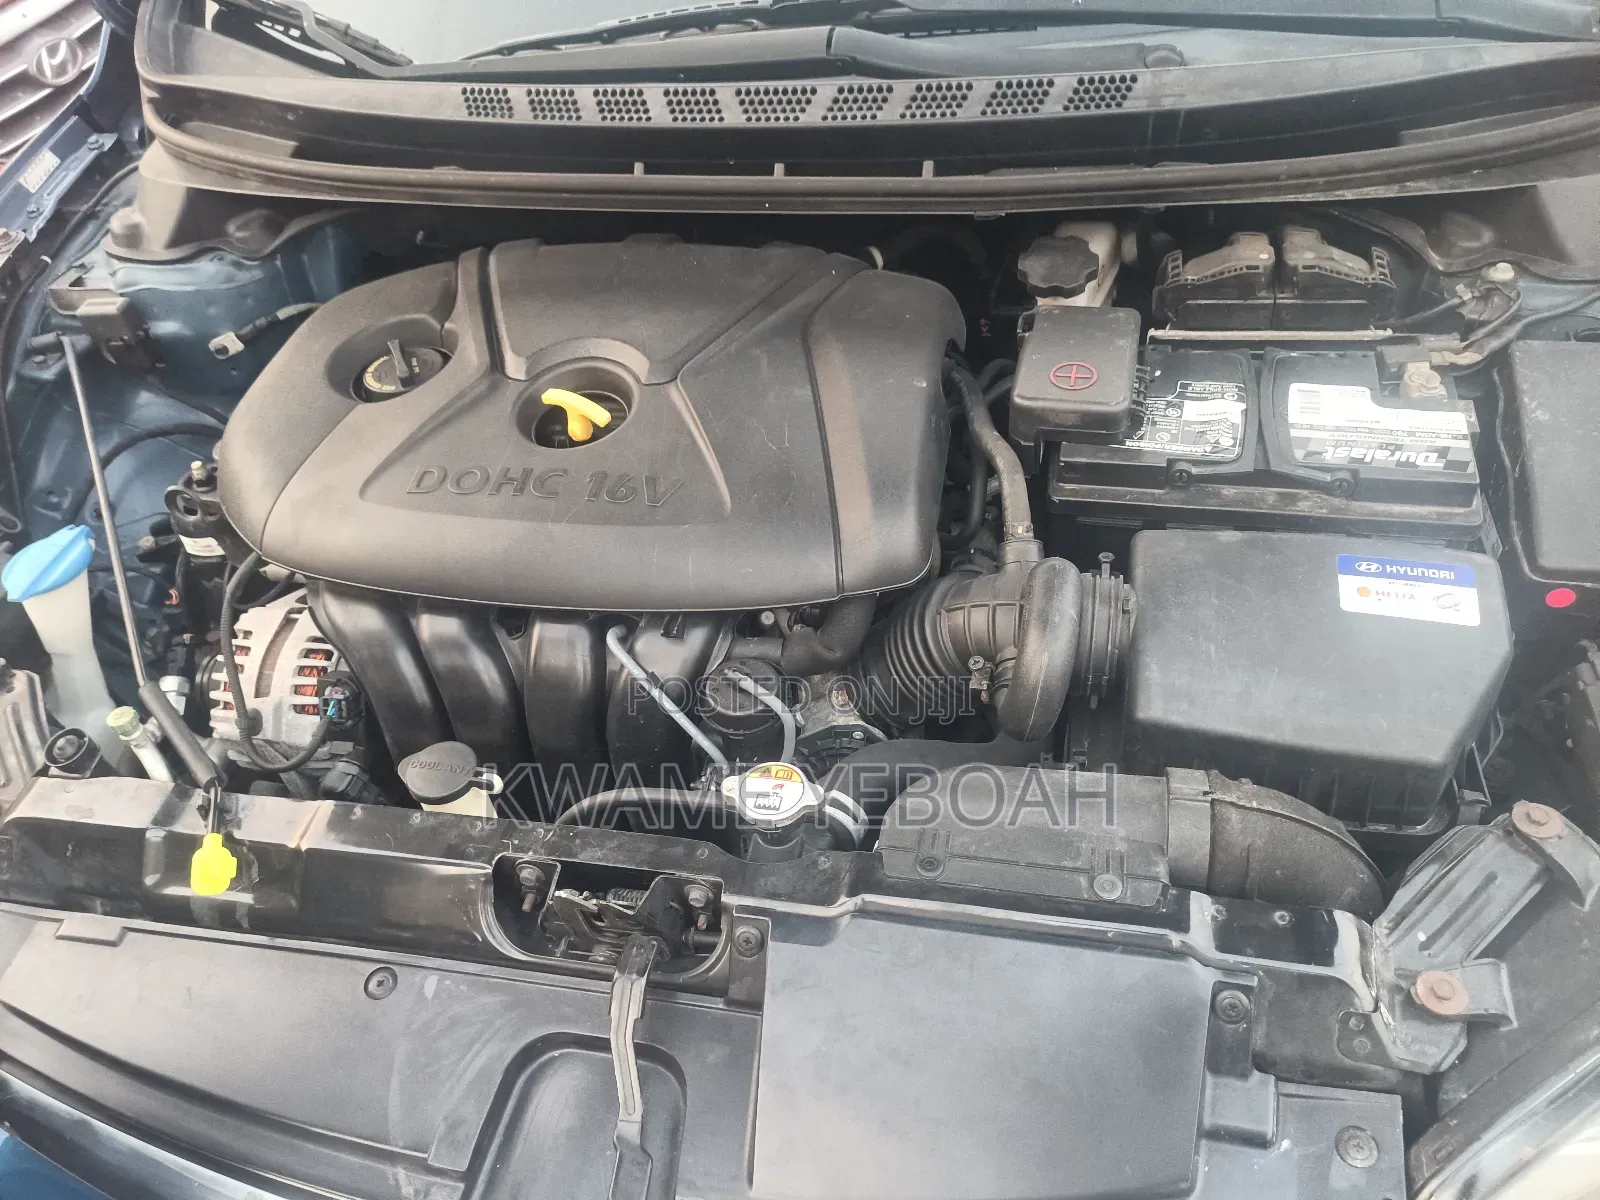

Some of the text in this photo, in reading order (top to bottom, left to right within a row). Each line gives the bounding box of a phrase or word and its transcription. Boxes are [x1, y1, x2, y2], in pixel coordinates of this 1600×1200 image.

[1326, 439, 1396, 451] PLATINUM
[1321, 445, 1444, 468] Duralast
[406, 465, 685, 507] DOHC 16V
[1386, 564, 1455, 580] HYUNDAI
[1375, 590, 1416, 600] HELIX
